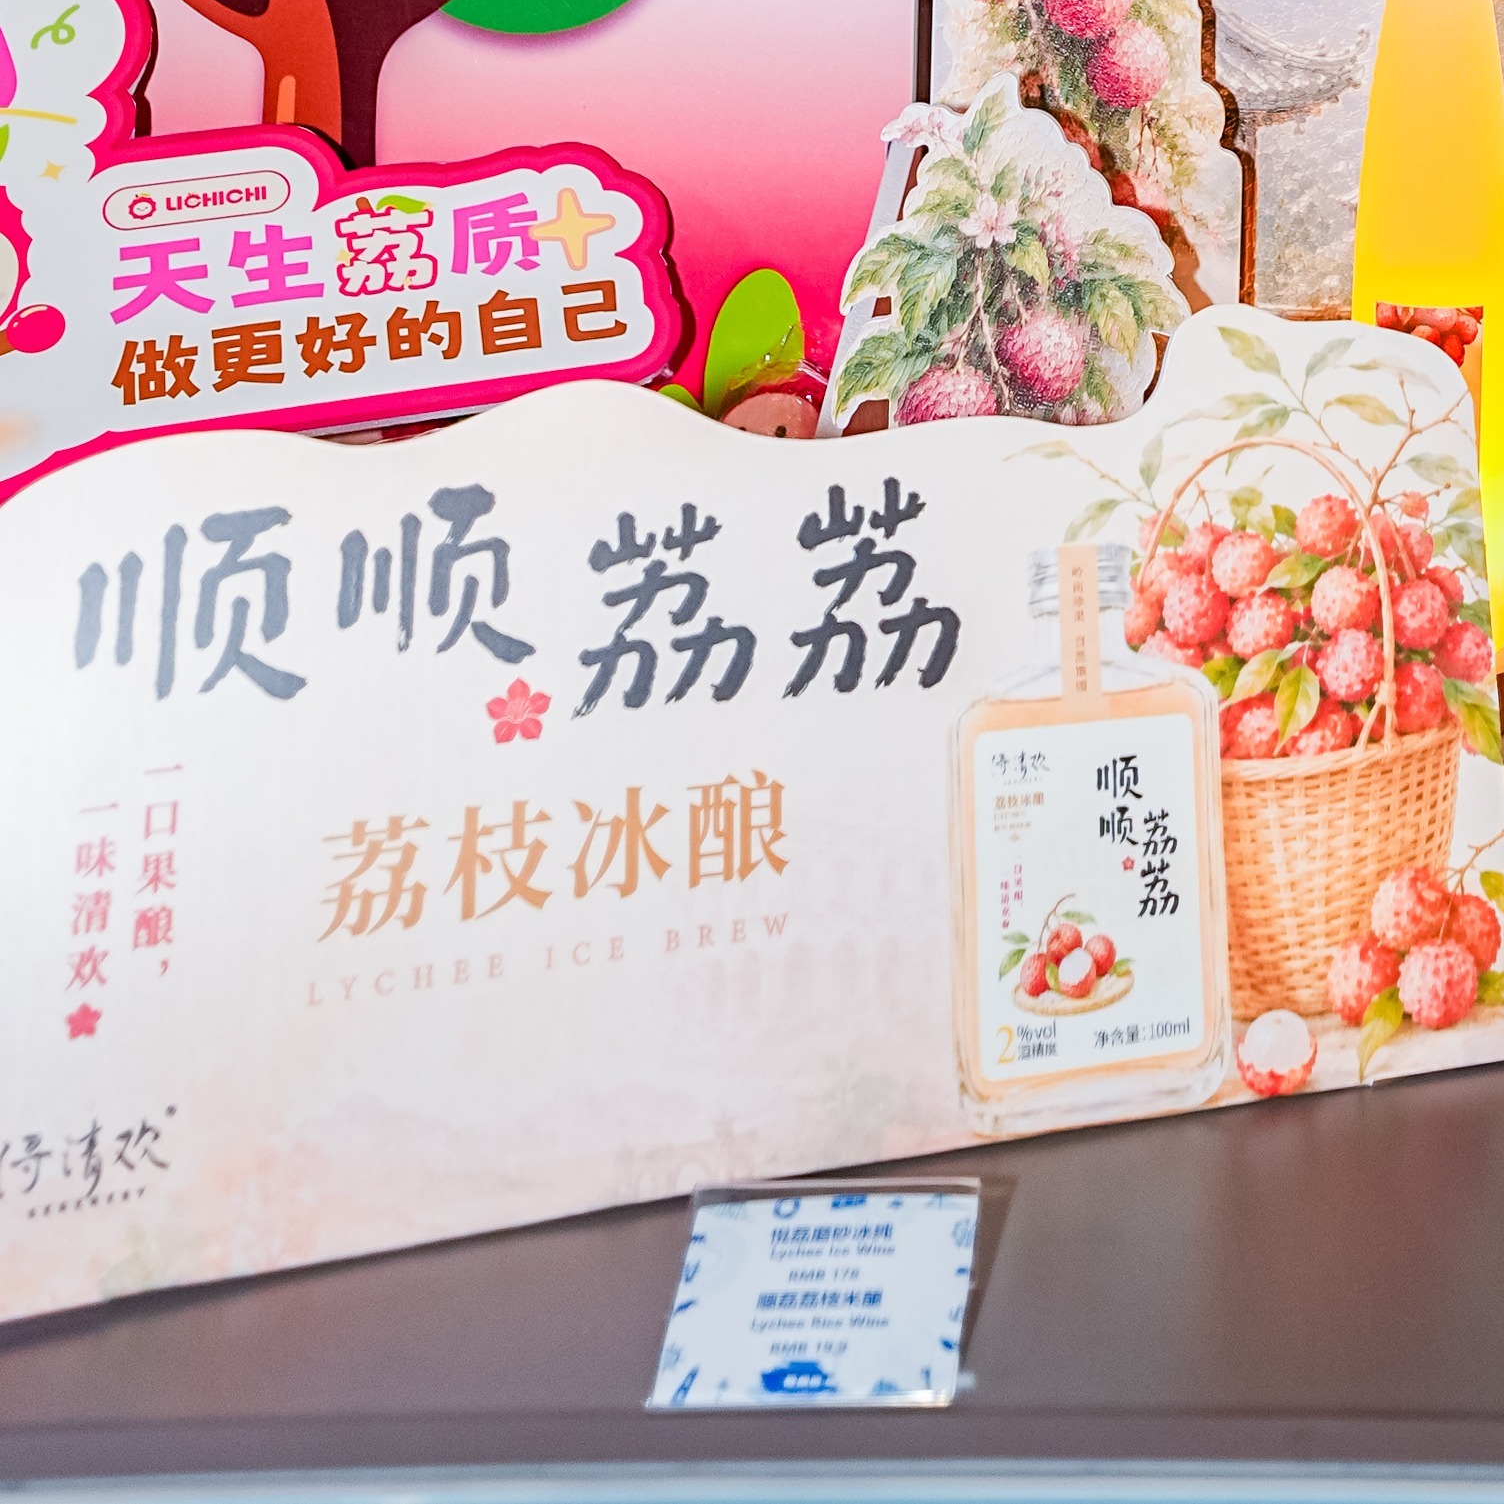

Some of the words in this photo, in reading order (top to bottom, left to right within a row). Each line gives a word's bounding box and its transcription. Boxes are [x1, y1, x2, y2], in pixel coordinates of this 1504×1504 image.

[166, 186, 267, 211] LICHICHI
[110, 193, 541, 325] 天生荔质
[111, 280, 628, 406] 做更好的自己
[74, 475, 962, 721] 顺顺荔荔
[66, 805, 117, 992] 一味清欢
[316, 768, 790, 944] 荔枝冰酿
[306, 953, 508, 1007] LYCHEE
[544, 935, 626, 972] ICE
[665, 911, 792, 953] BREW
[996, 1024, 1016, 1065] 2
[770, 1245, 823, 1262] Lychee
[829, 1245, 850, 1256] Ice
[856, 1244, 896, 1256] Wine
[788, 1269, 826, 1282] RMB
[751, 1317, 805, 1334] Lychee
[850, 1316, 890, 1329] Wine
